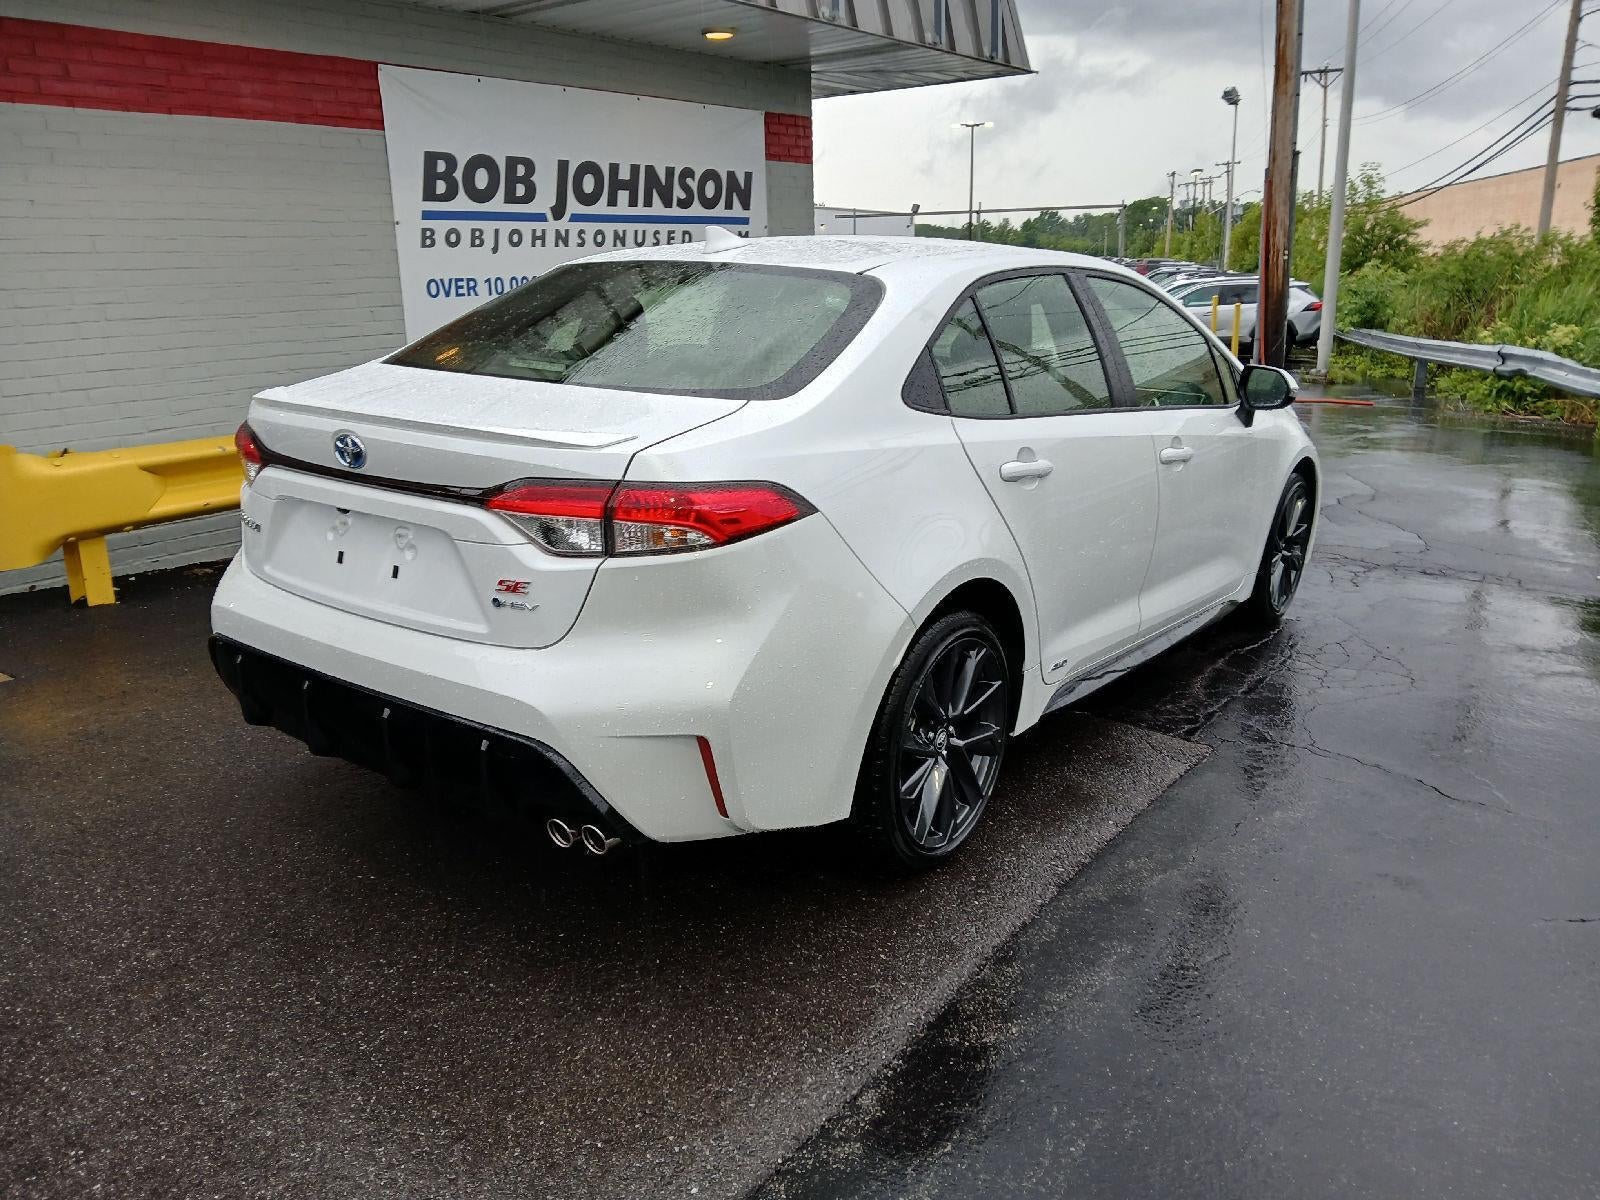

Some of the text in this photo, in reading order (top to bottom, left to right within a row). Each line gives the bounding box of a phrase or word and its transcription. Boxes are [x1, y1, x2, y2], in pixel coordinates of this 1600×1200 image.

[422, 151, 753, 221] BOB JOHNSON
[426, 277, 479, 298] OVER
[495, 579, 532, 595] SE
